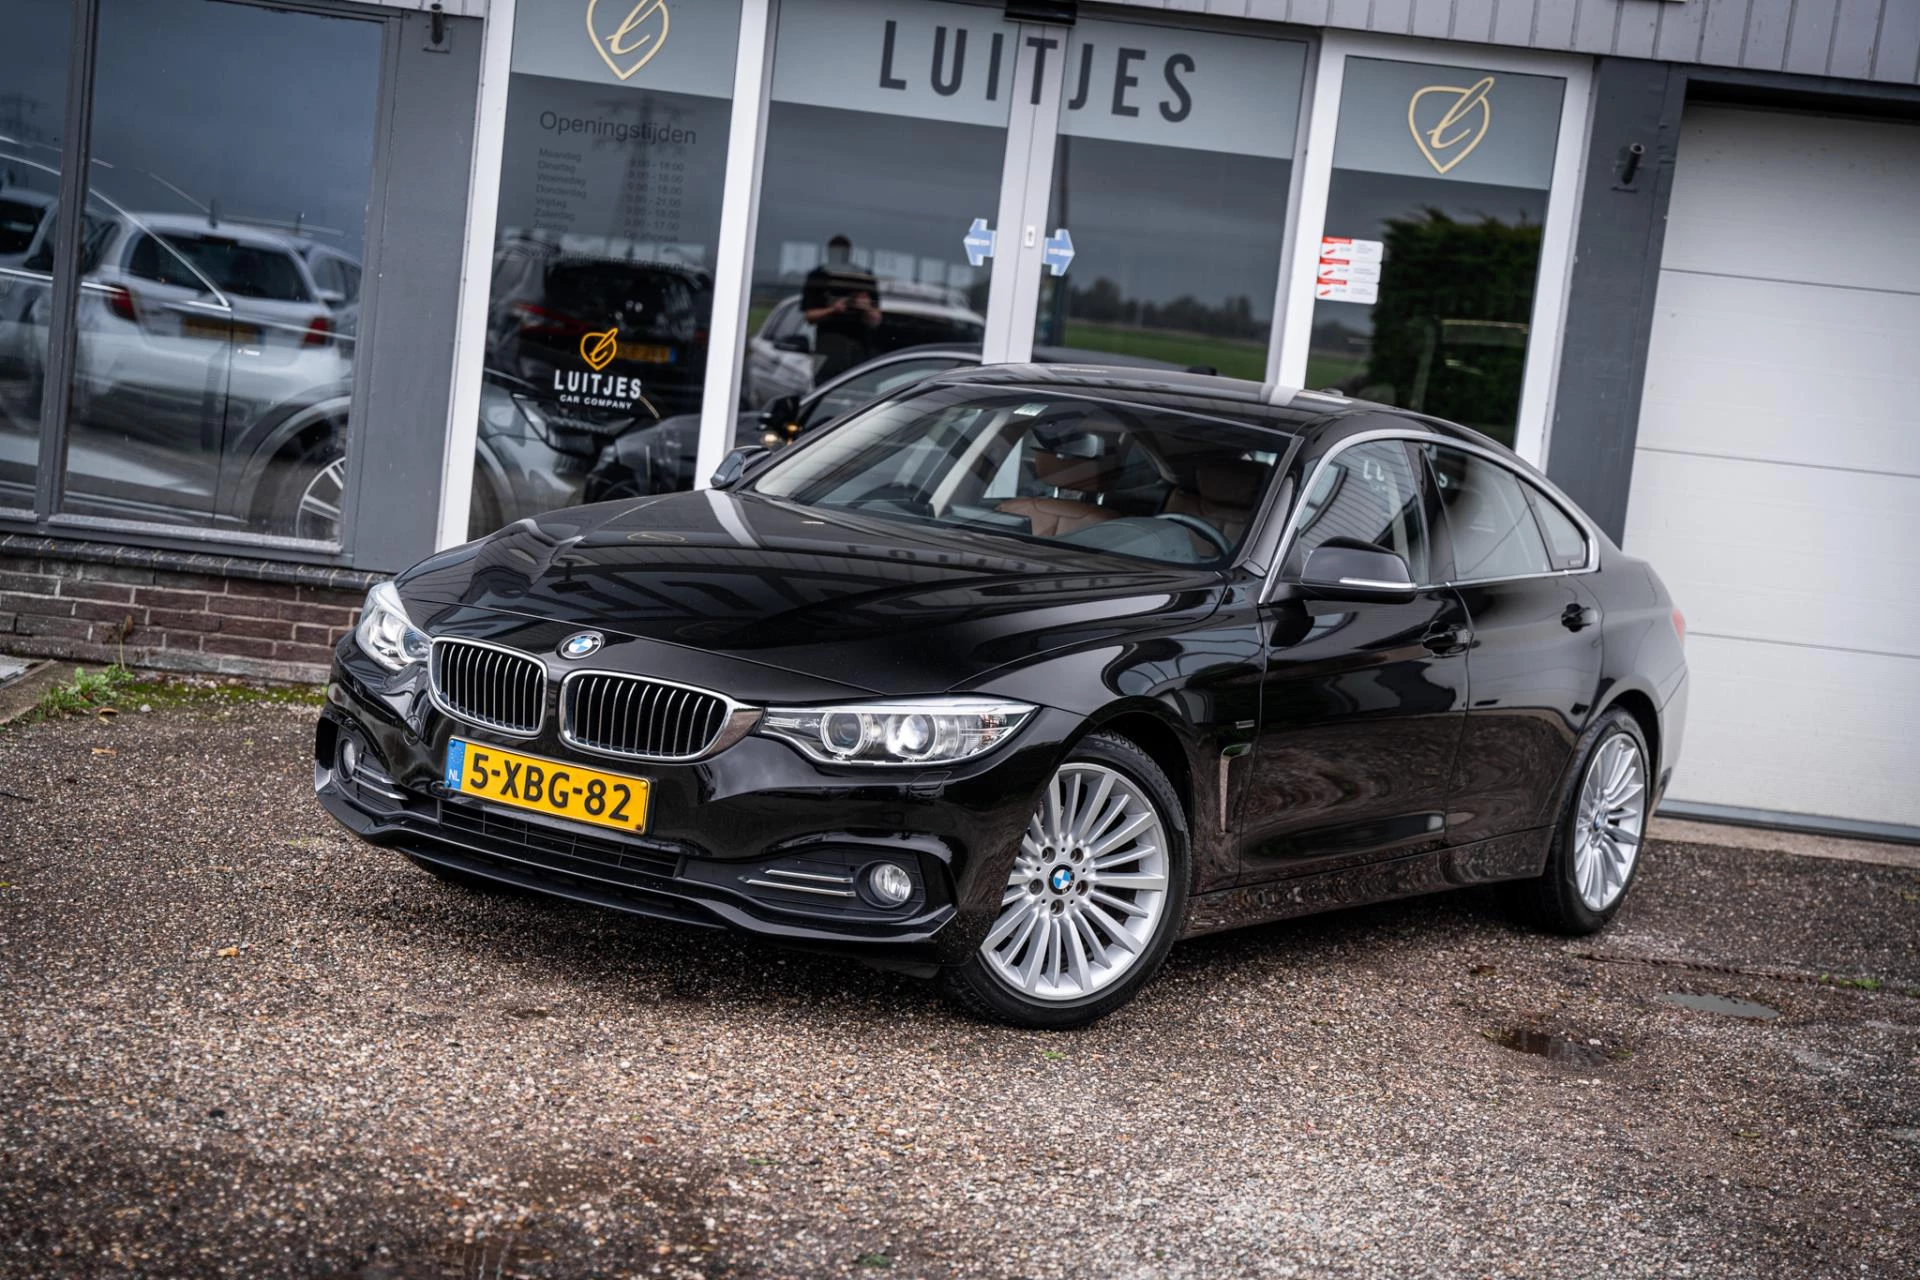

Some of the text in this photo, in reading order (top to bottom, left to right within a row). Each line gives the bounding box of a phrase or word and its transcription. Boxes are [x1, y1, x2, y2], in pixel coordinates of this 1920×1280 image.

[878, 20, 1196, 123] LUITJES
[539, 110, 697, 145] Openingstijden
[553, 369, 642, 399] LUITJES
[559, 394, 633, 410] CAR COMPANY
[447, 767, 461, 783] NL
[469, 752, 632, 823] 5-XBG-82
